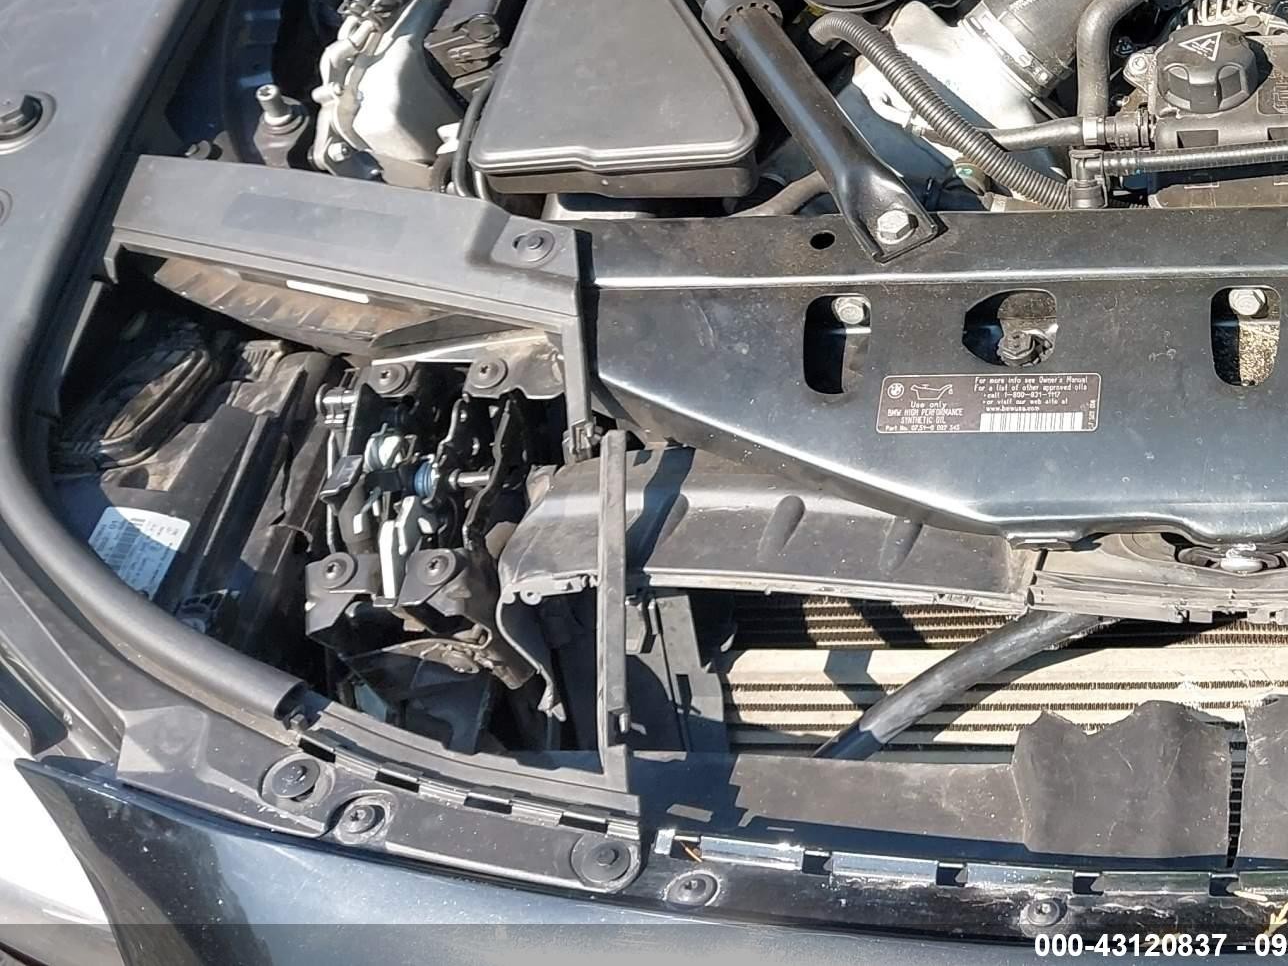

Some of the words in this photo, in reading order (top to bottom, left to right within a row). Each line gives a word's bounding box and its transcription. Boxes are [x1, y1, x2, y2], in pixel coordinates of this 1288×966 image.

[1042, 384, 1072, 392] approved
[930, 401, 947, 409] only
[921, 408, 964, 416] PERFORMANCE
